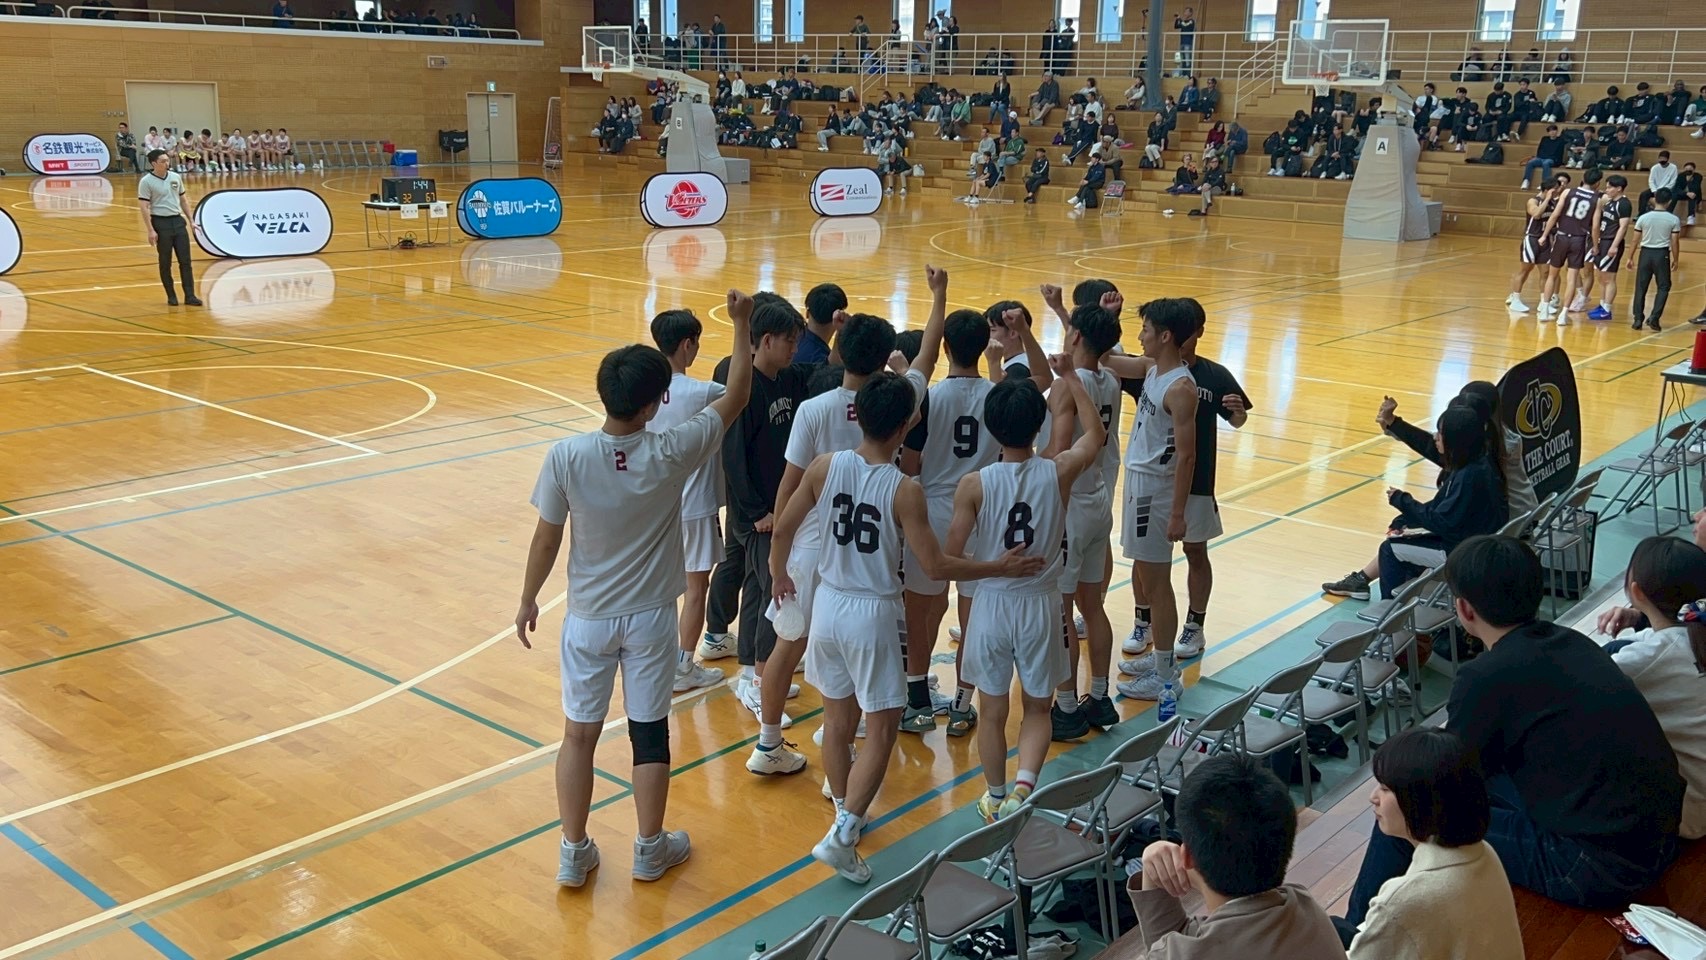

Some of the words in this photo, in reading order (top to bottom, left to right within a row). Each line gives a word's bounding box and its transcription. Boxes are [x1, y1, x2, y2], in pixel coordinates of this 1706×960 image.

[42, 141, 85, 155] 名鉄観光
[1377, 141, 1386, 151] A
[413, 180, 429, 190] 1:44
[845, 183, 868, 195] Zeal
[425, 192, 436, 203] 67
[251, 211, 309, 220] NAGASAKI
[493, 198, 557, 216] 佐賀バルーナーズ
[1566, 197, 1591, 220] 18
[255, 221, 311, 235] VELCA
[846, 403, 858, 422] 2
[953, 415, 979, 459] 9
[614, 450, 628, 471] 2
[1525, 446, 1544, 473] THE
[1544, 430, 1571, 460] COURT
[1556, 452, 1571, 472] GEAR
[832, 492, 880, 554] 36
[1003, 501, 1035, 551] 8
